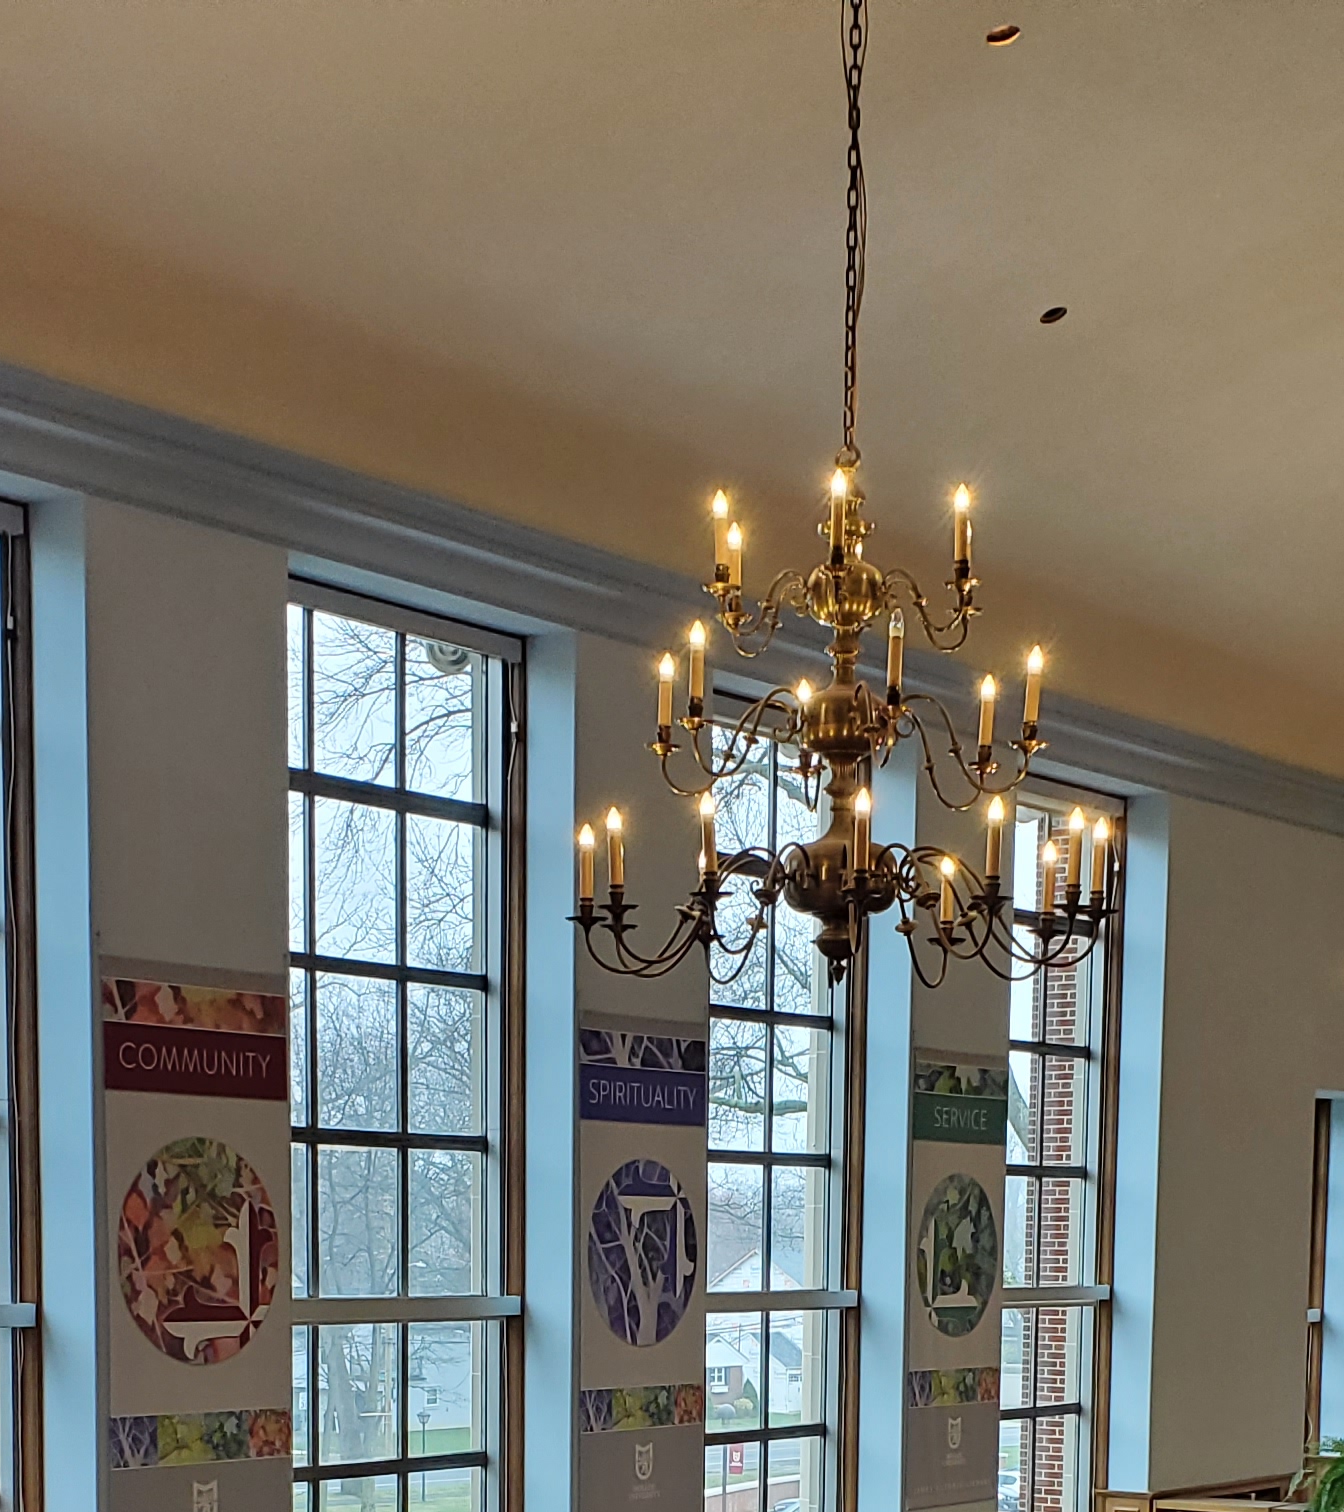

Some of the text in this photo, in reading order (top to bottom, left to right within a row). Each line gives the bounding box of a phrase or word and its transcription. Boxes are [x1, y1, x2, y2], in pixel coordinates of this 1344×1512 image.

[119, 1041, 271, 1079] COMMUNITY
[589, 1079, 697, 1110] SPIRITUALITY
[933, 1106, 988, 1130] SERVICE
